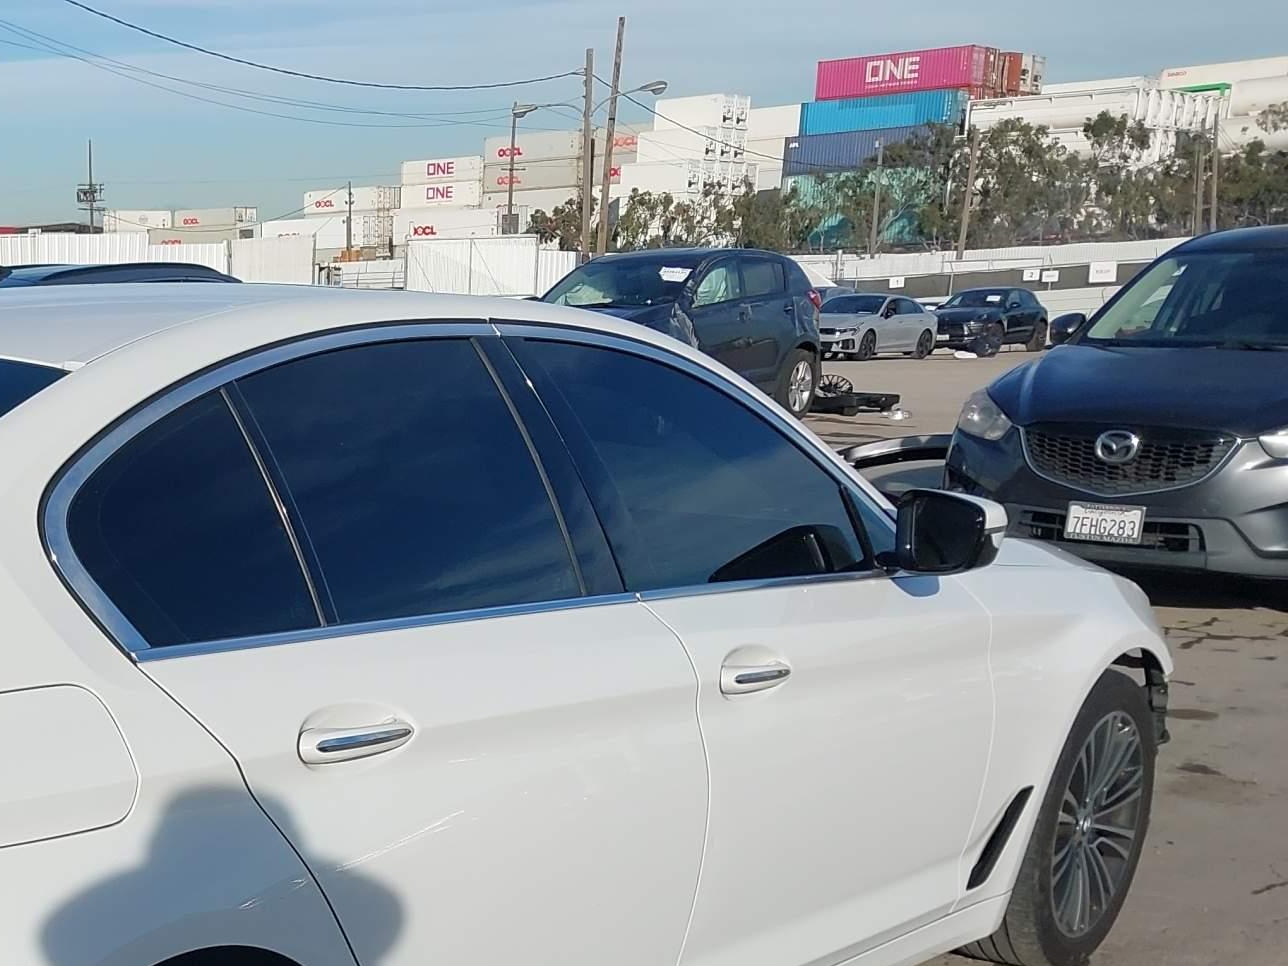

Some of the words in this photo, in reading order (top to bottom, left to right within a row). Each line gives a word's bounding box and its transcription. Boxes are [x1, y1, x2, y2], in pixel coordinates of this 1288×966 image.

[865, 56, 920, 82] ONE
[427, 162, 454, 176] ONE
[426, 186, 453, 200] ONE
[315, 200, 334, 208] OOCL
[1073, 516, 1136, 537] 7FHG283
